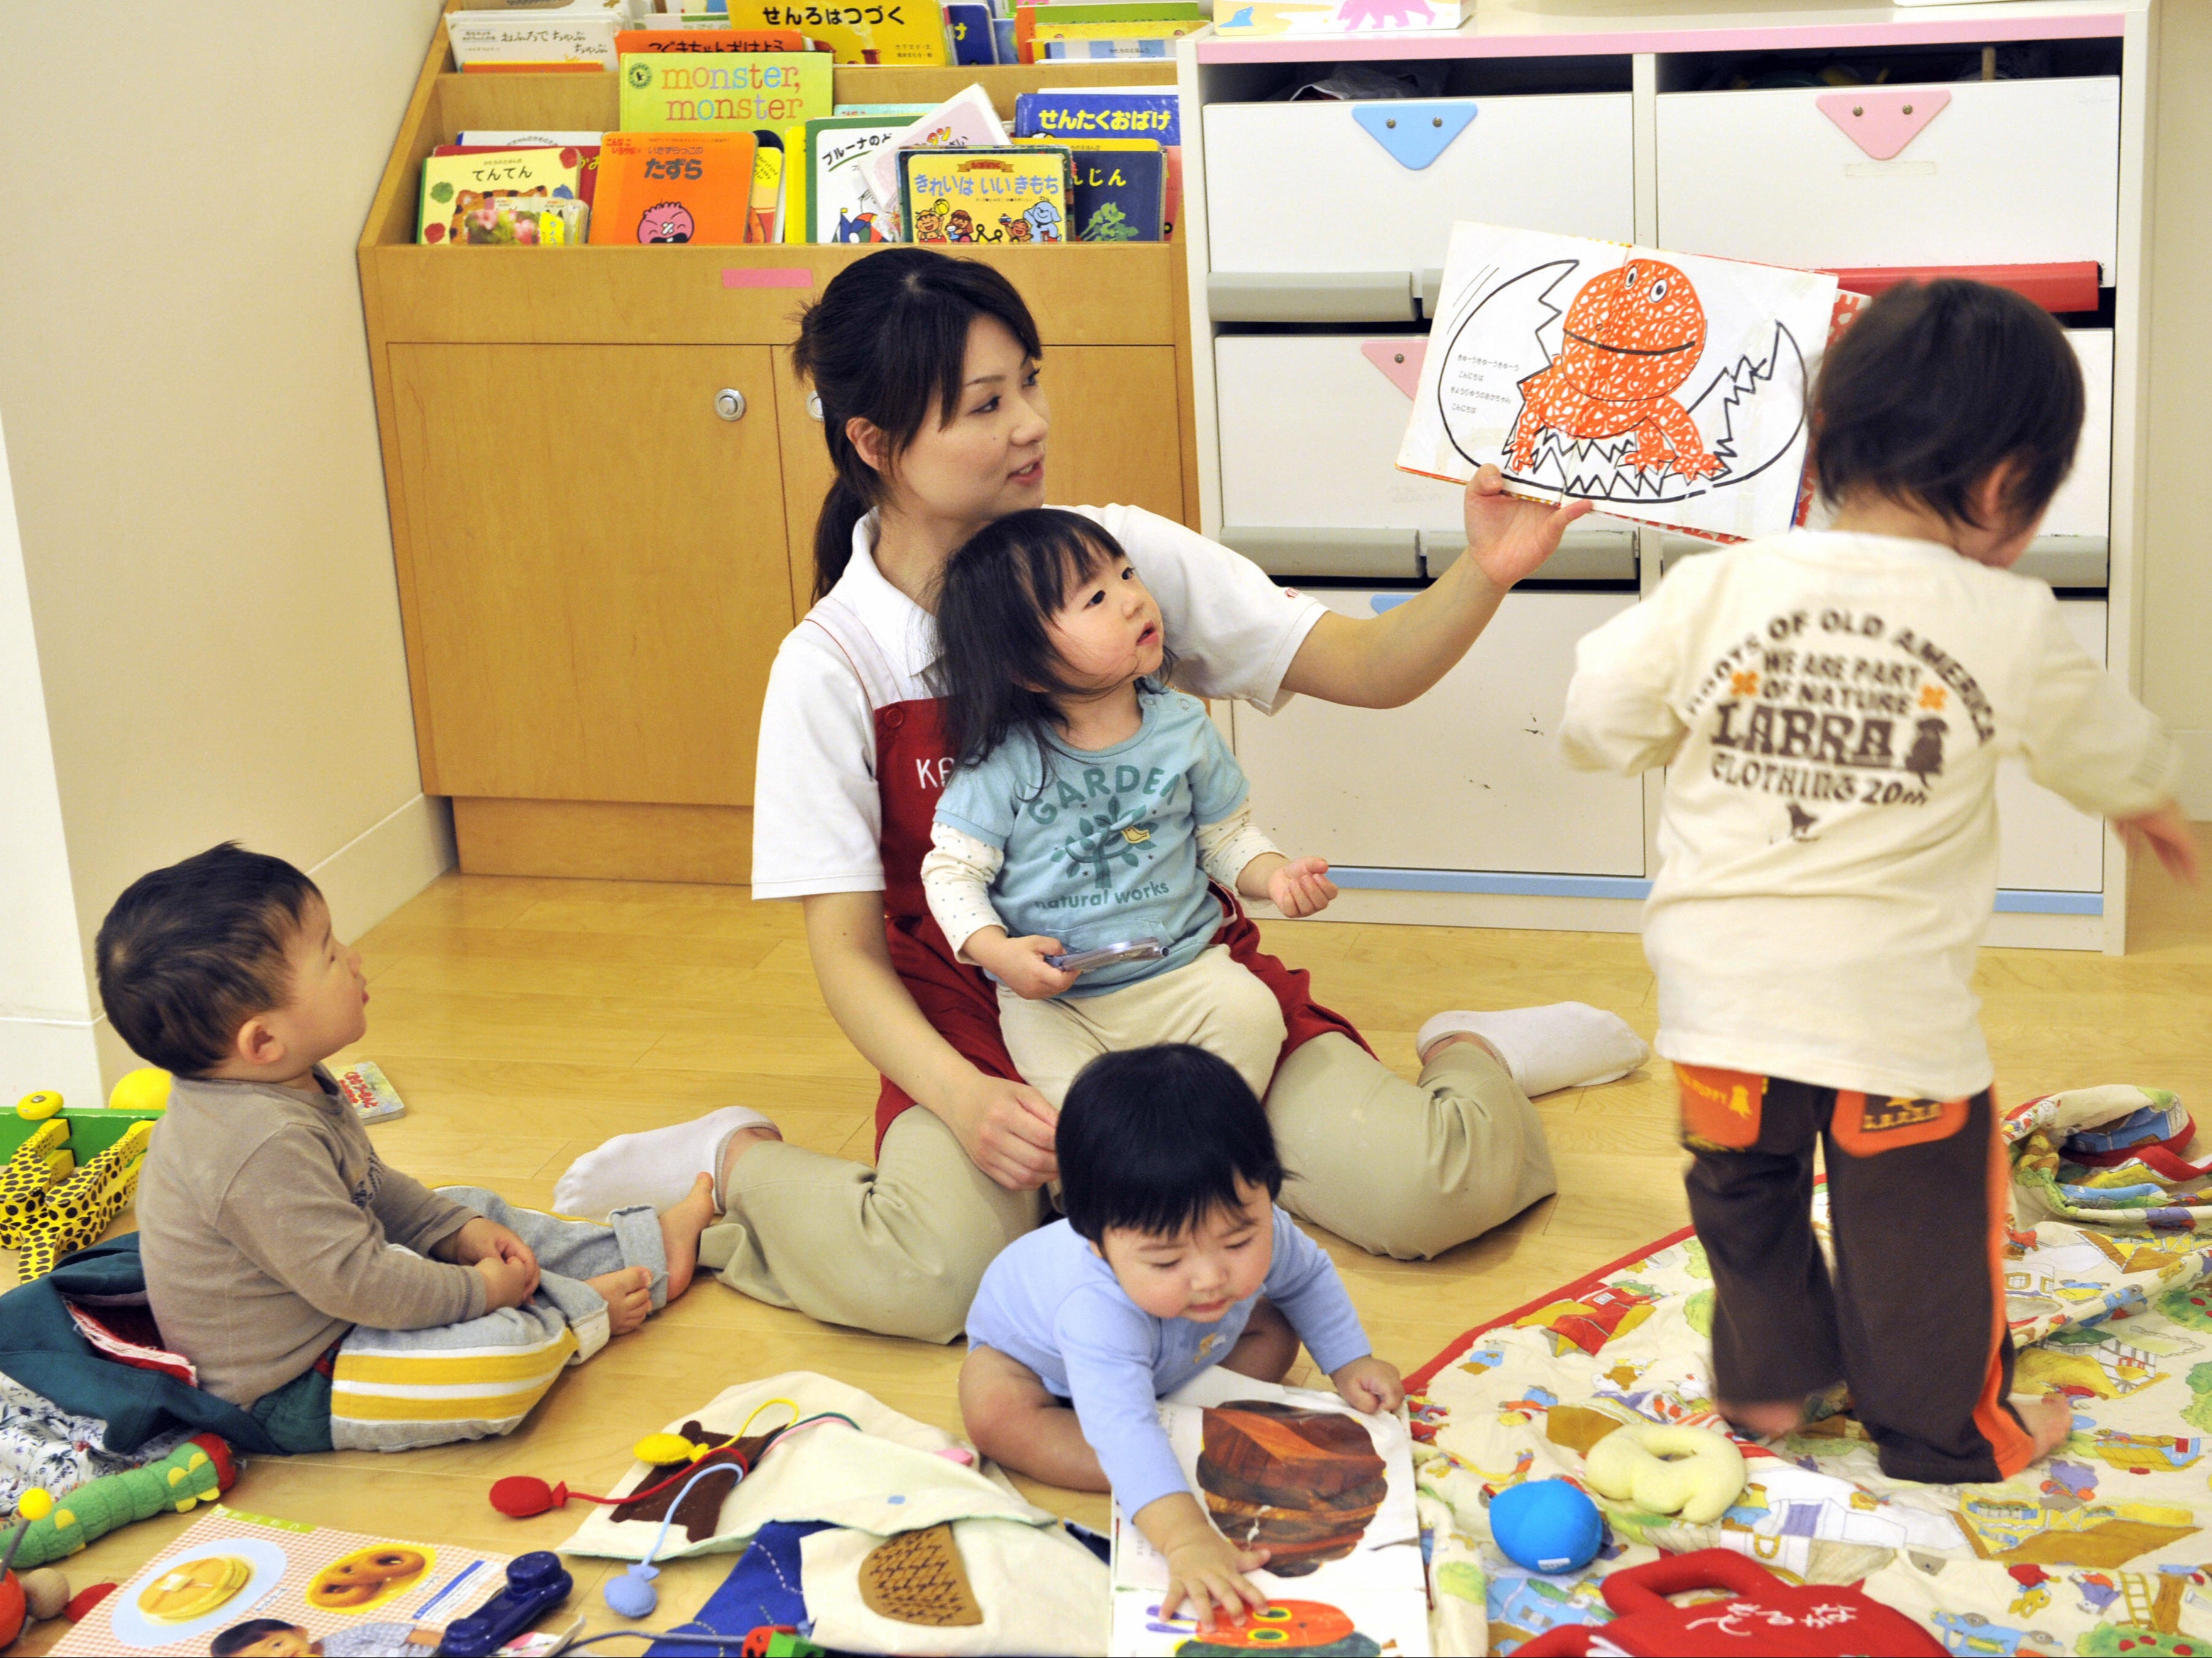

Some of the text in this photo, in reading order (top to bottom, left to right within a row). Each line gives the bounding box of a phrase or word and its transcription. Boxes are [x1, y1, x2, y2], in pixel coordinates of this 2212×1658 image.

[763, 6, 905, 26] せんろはつづく
[661, 63, 801, 94] monster,
[666, 94, 804, 121] monster
[1039, 109, 1171, 130] せんたくおばけ
[472, 166, 533, 182] てんてん
[643, 157, 704, 180] たずら
[913, 173, 1060, 197] きれいは いい きもち
[1458, 370, 1484, 382] こんにちは
[1451, 402, 1477, 414] こんにちは
[1767, 610, 1808, 642] OF
[1820, 608, 1886, 638] OLD
[1034, 882, 1170, 910] natural works
